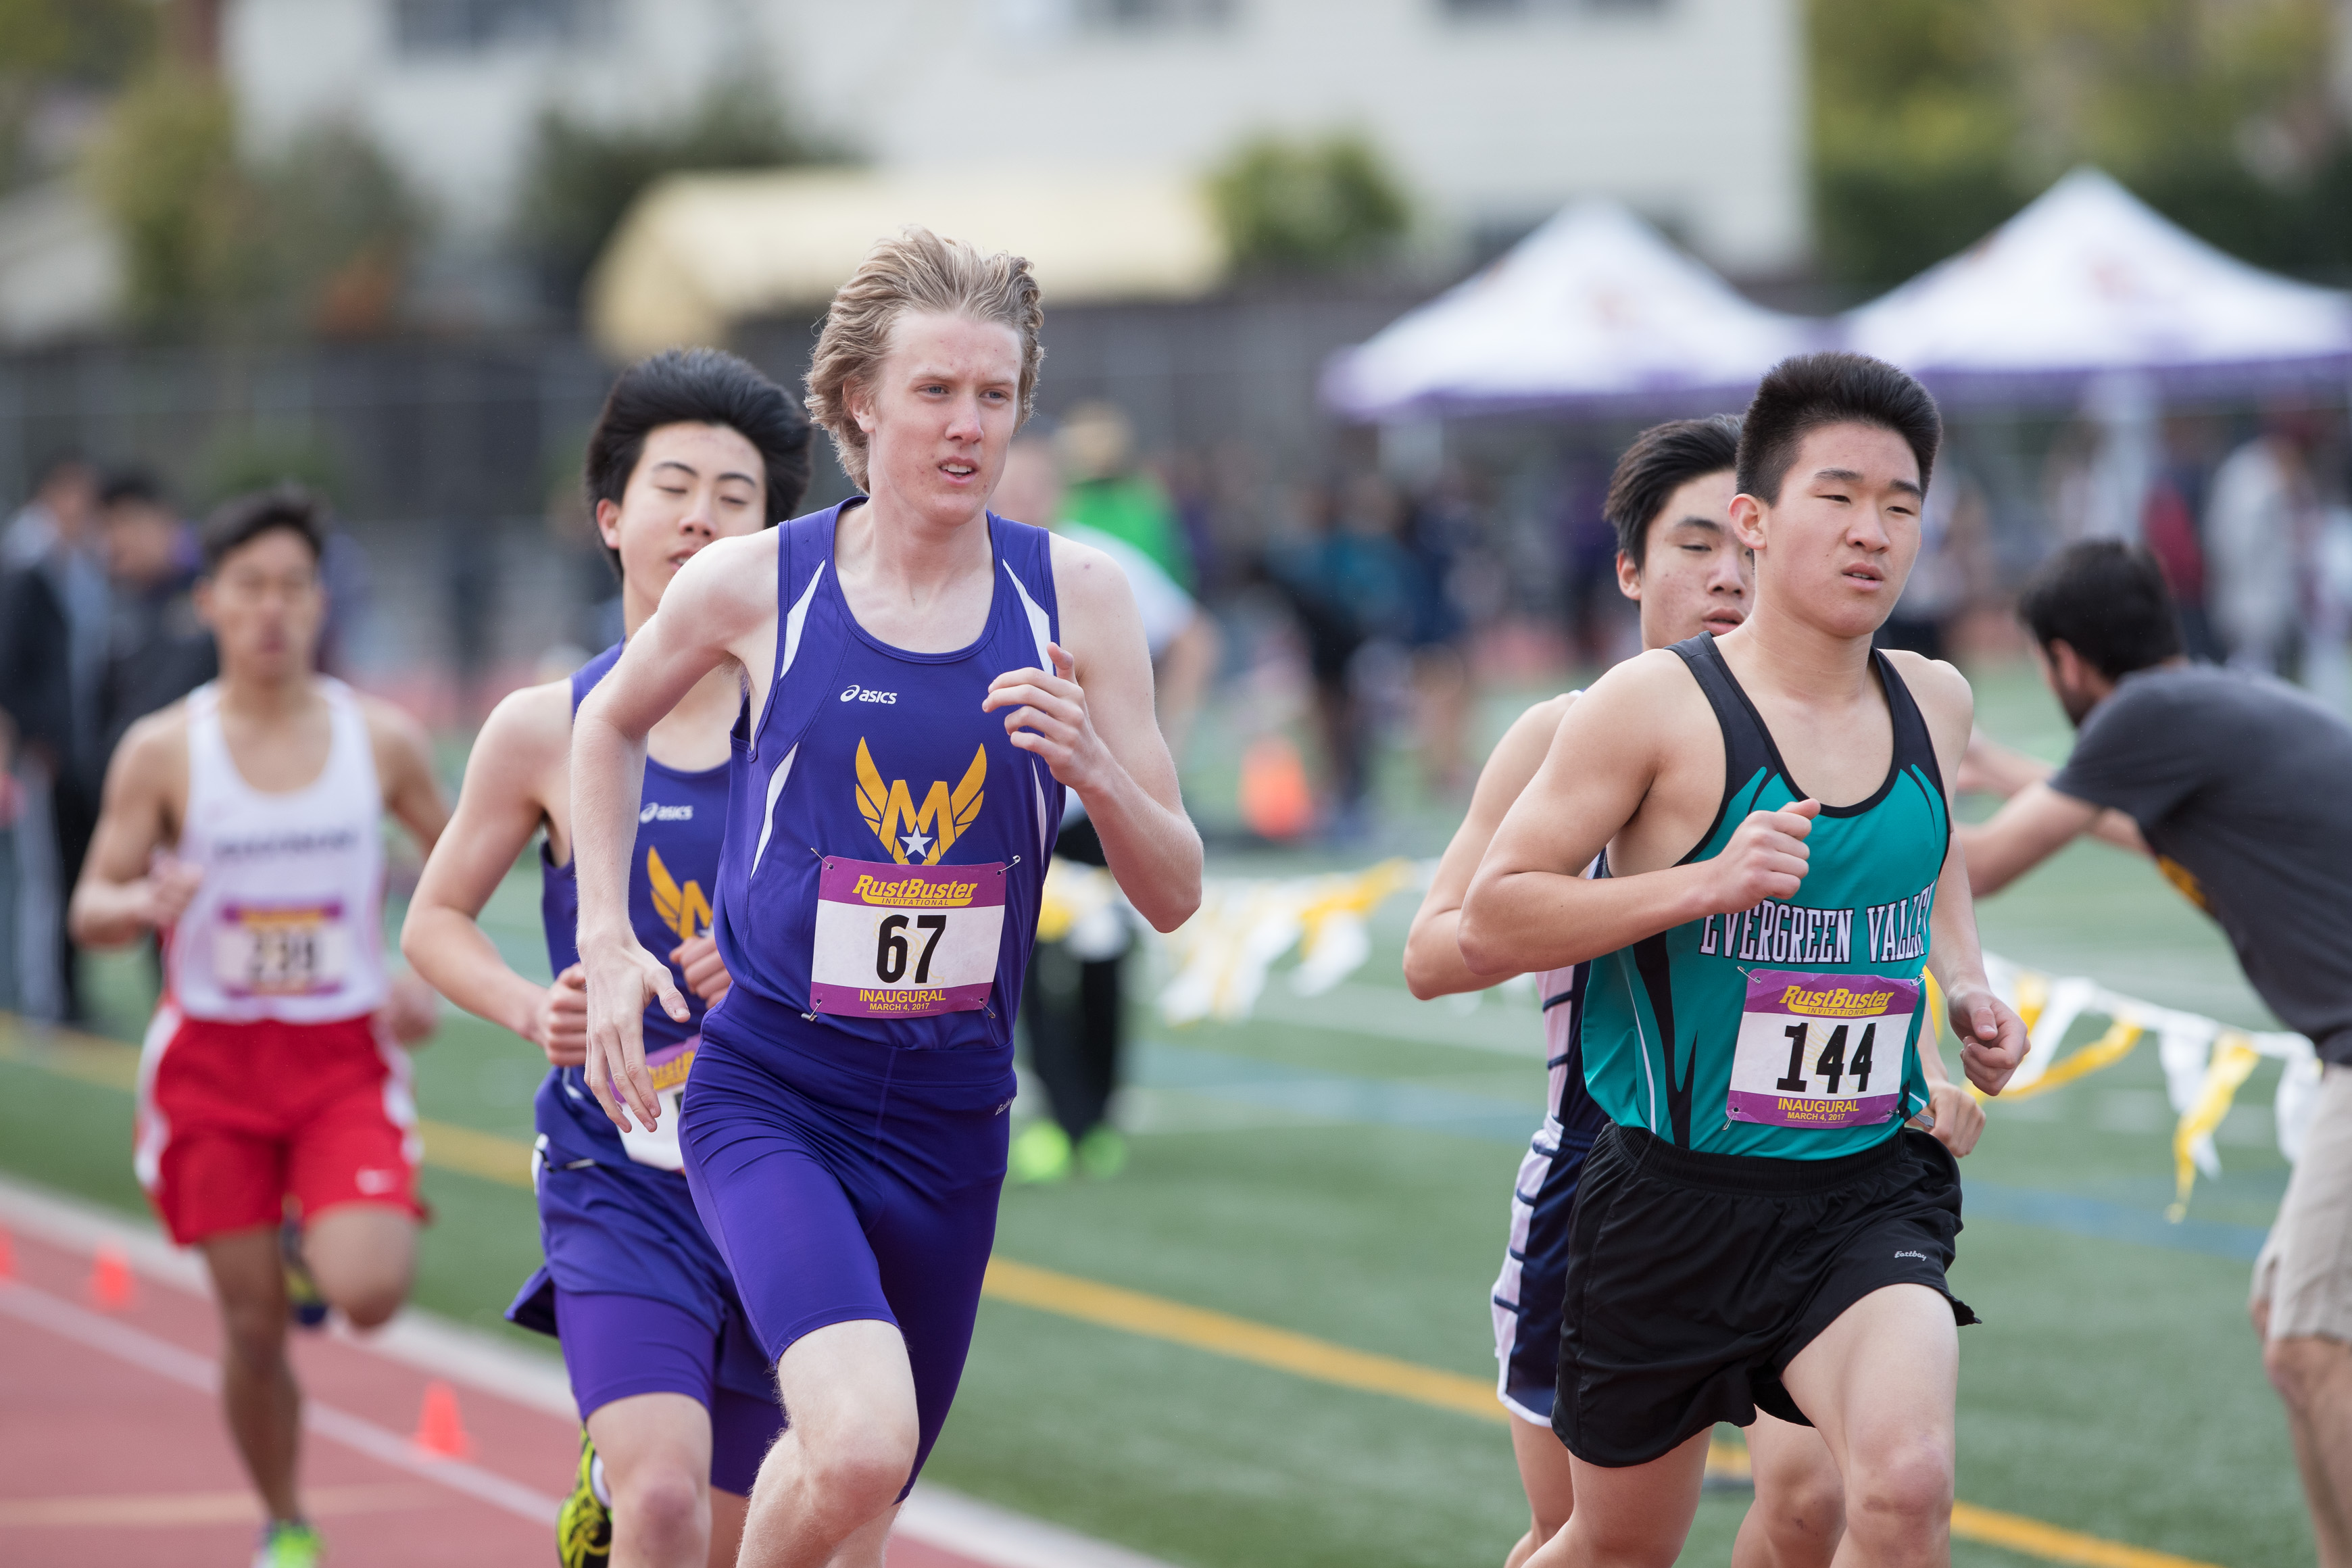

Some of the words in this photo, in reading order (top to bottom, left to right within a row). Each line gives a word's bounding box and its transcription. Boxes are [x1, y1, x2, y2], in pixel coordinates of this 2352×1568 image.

[858, 689, 898, 704] asics
[852, 875, 978, 900] RustBuster
[881, 898, 949, 906] INVITATIONAL
[1698, 898, 1855, 964] EVERGREEN
[876, 914, 946, 984] 67
[859, 989, 946, 1003] INAUGURAL
[1779, 985, 1894, 1008] RustBuster
[912, 1002, 930, 1010] 2017
[1807, 1007, 1868, 1016] INVITATIONAL
[1776, 1023, 1876, 1094] 144
[1778, 1098, 1859, 1113] INAUGURAL
[1787, 1112, 1818, 1120] MARCH
[1894, 1250, 1927, 1261] Eastbay
